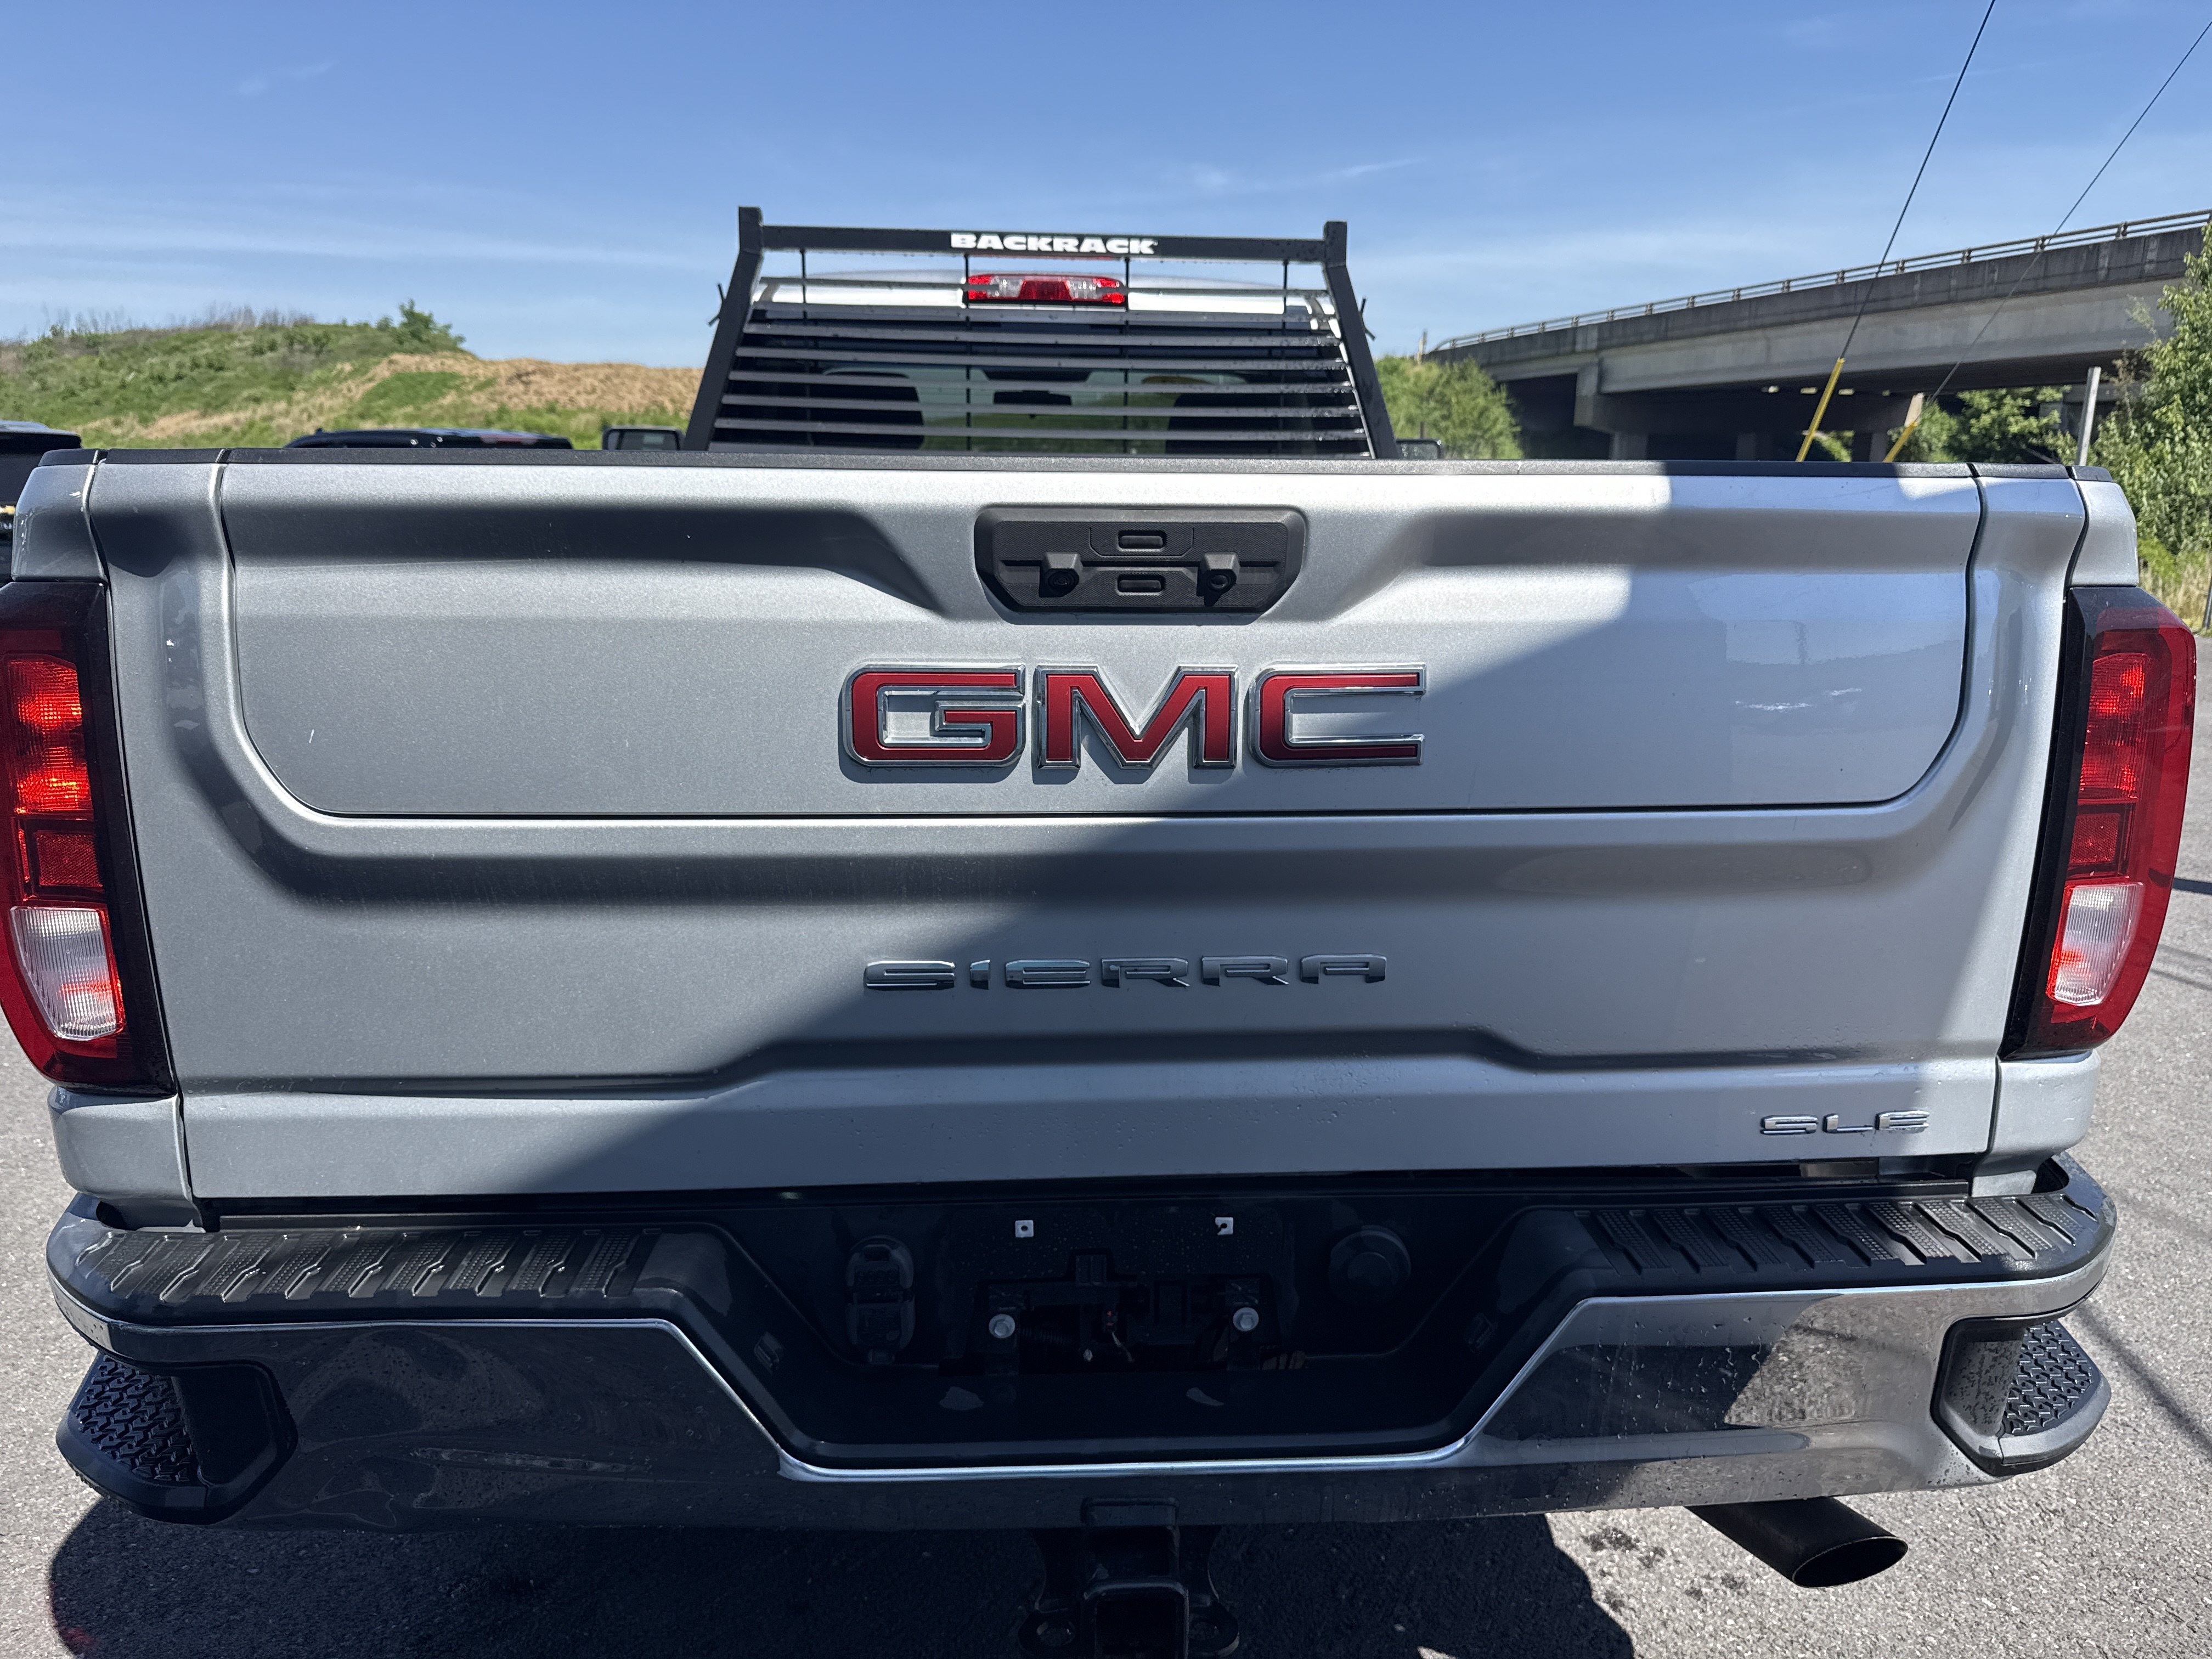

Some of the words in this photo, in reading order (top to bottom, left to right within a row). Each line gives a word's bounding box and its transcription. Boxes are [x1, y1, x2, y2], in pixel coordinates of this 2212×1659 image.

[950, 232, 1155, 254] BACKRACK
[843, 664, 1426, 769] GMC
[865, 954, 1387, 989] SIERRA
[1760, 1110, 1930, 1135] SLE
